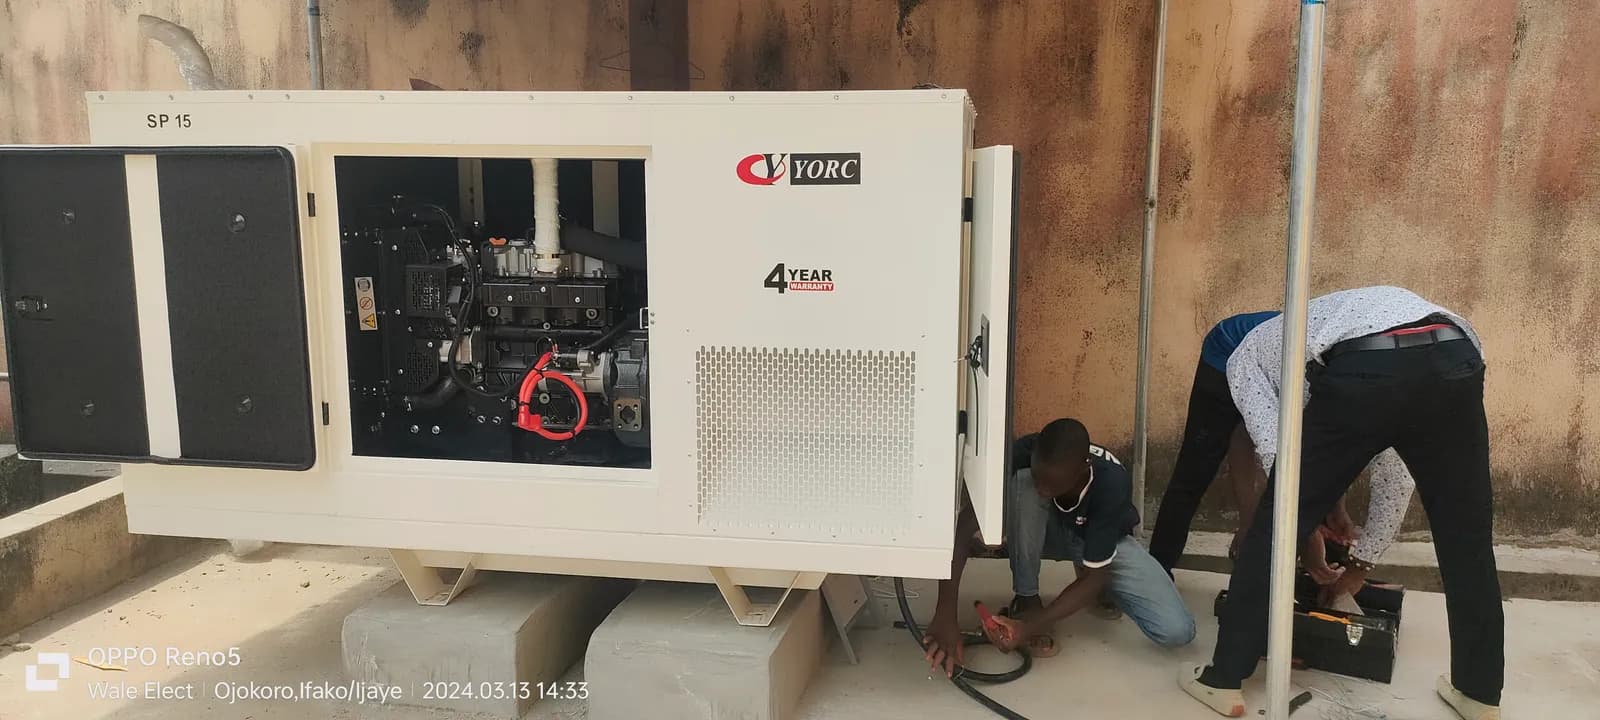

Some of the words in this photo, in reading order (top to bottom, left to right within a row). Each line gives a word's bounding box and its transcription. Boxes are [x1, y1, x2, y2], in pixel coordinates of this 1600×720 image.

[147, 114, 170, 129] SP
[175, 114, 192, 128] 15
[794, 159, 858, 179] YORC
[763, 262, 788, 294] 4
[788, 269, 833, 282] YEAR
[790, 282, 833, 292] WARRANTY
